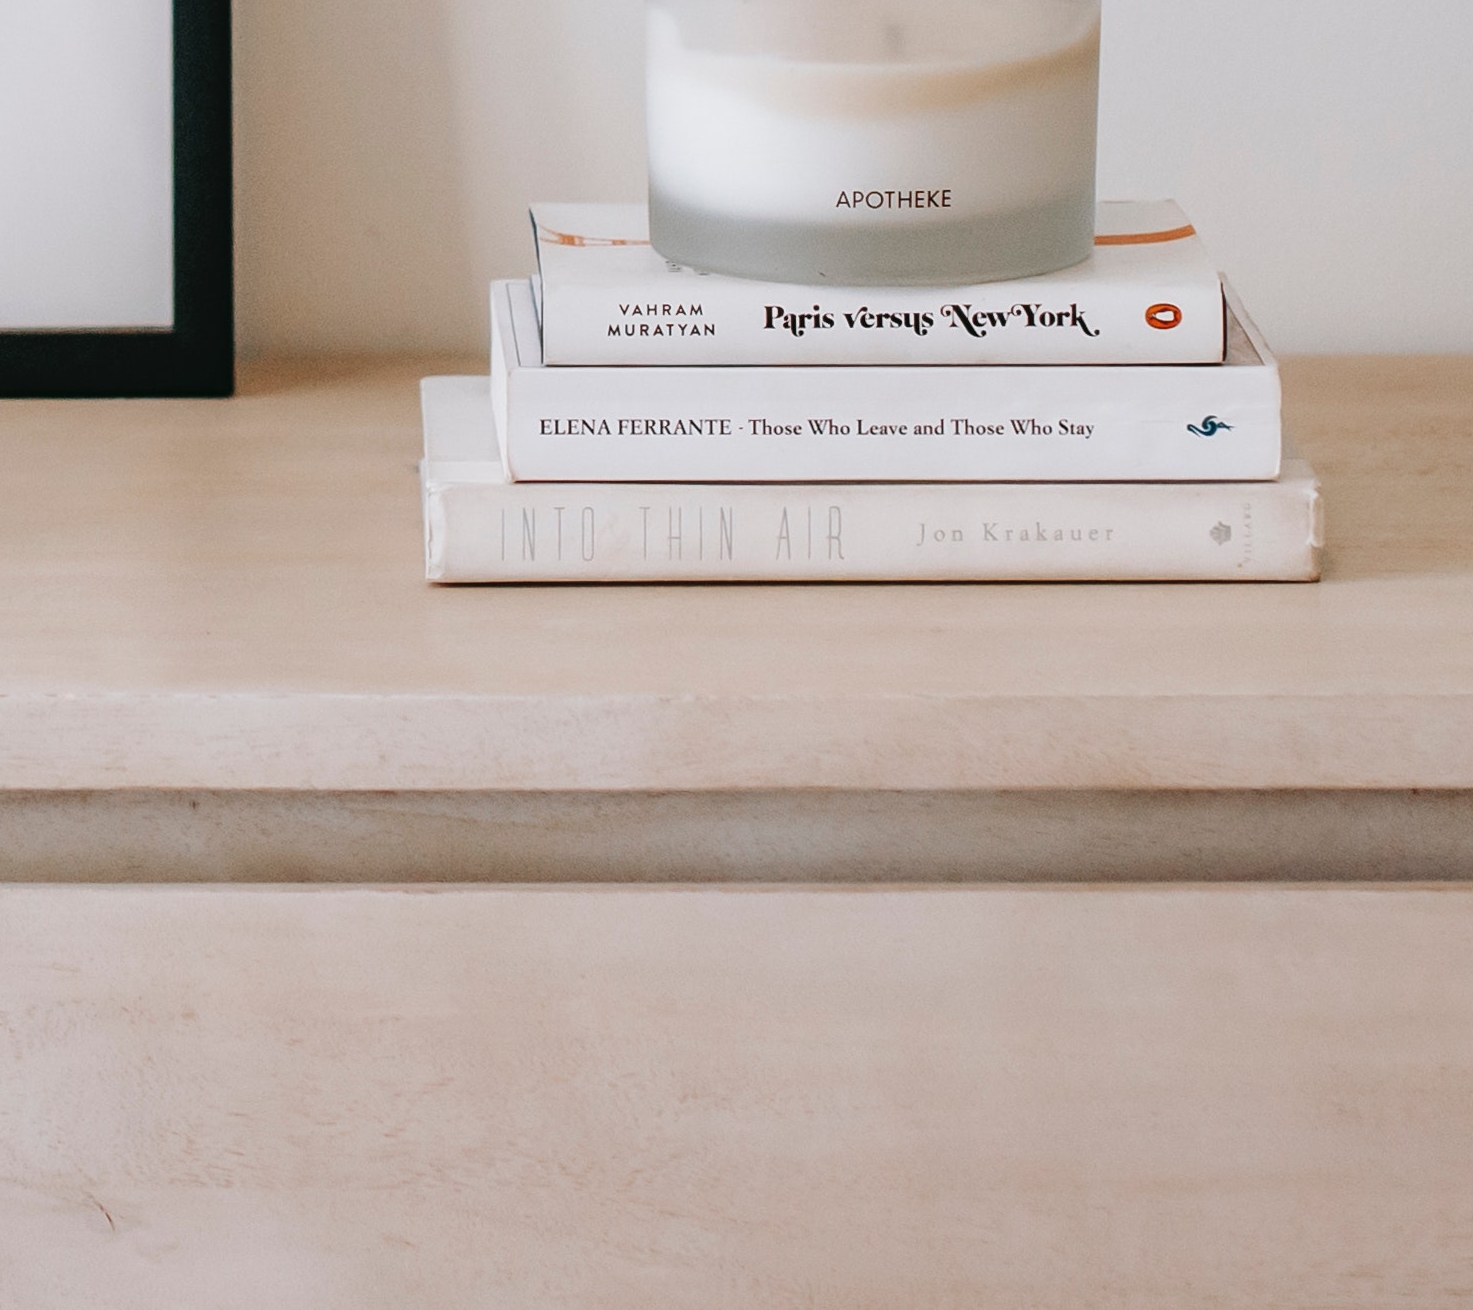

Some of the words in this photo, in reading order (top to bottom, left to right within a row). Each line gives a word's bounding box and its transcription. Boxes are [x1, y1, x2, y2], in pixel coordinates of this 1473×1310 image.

[835, 189, 952, 209] APOTHEKE
[618, 303, 704, 317] VAHRAM
[763, 304, 835, 338] Paris
[842, 306, 934, 337] versus
[939, 303, 1011, 338] New
[1009, 303, 1101, 338] York
[607, 323, 716, 337] MURATYAN
[539, 418, 612, 436] ELENA
[617, 418, 732, 436] FERRANTE
[748, 418, 802, 436] Those
[807, 418, 850, 436] Who
[856, 418, 908, 436] Leave
[913, 418, 944, 436] and
[950, 418, 1004, 436] Those
[1010, 418, 1053, 436] Who
[1058, 418, 1095, 440] Stay
[501, 506, 595, 562] INTO
[639, 506, 733, 561] THIN
[775, 506, 845, 560] AIR
[916, 522, 964, 547] Jon
[982, 522, 1115, 542] Krakauer
